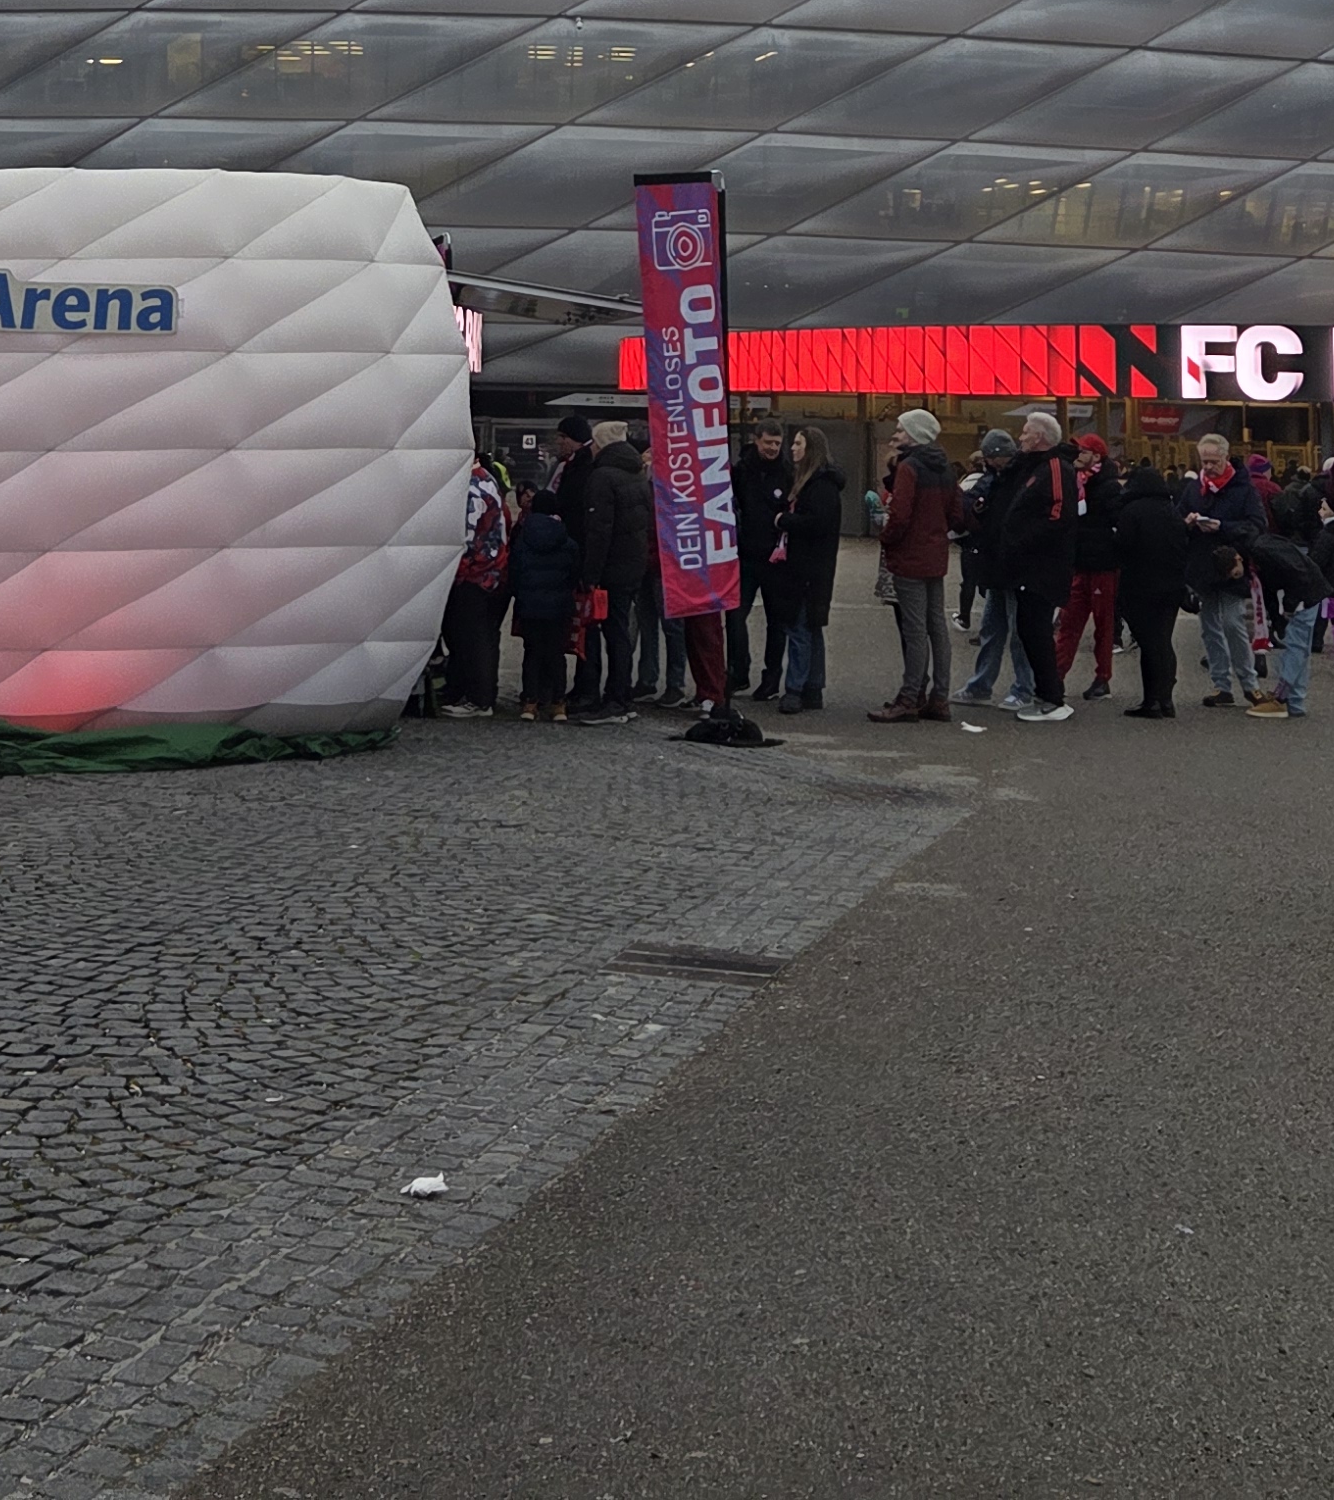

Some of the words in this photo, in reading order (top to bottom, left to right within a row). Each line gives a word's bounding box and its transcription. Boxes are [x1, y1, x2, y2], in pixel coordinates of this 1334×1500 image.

[662, 326, 697, 503] KOSTENLOSES
[679, 283, 739, 565] FANFOTO
[1180, 325, 1304, 401] FC
[673, 512, 702, 570] DEIN
